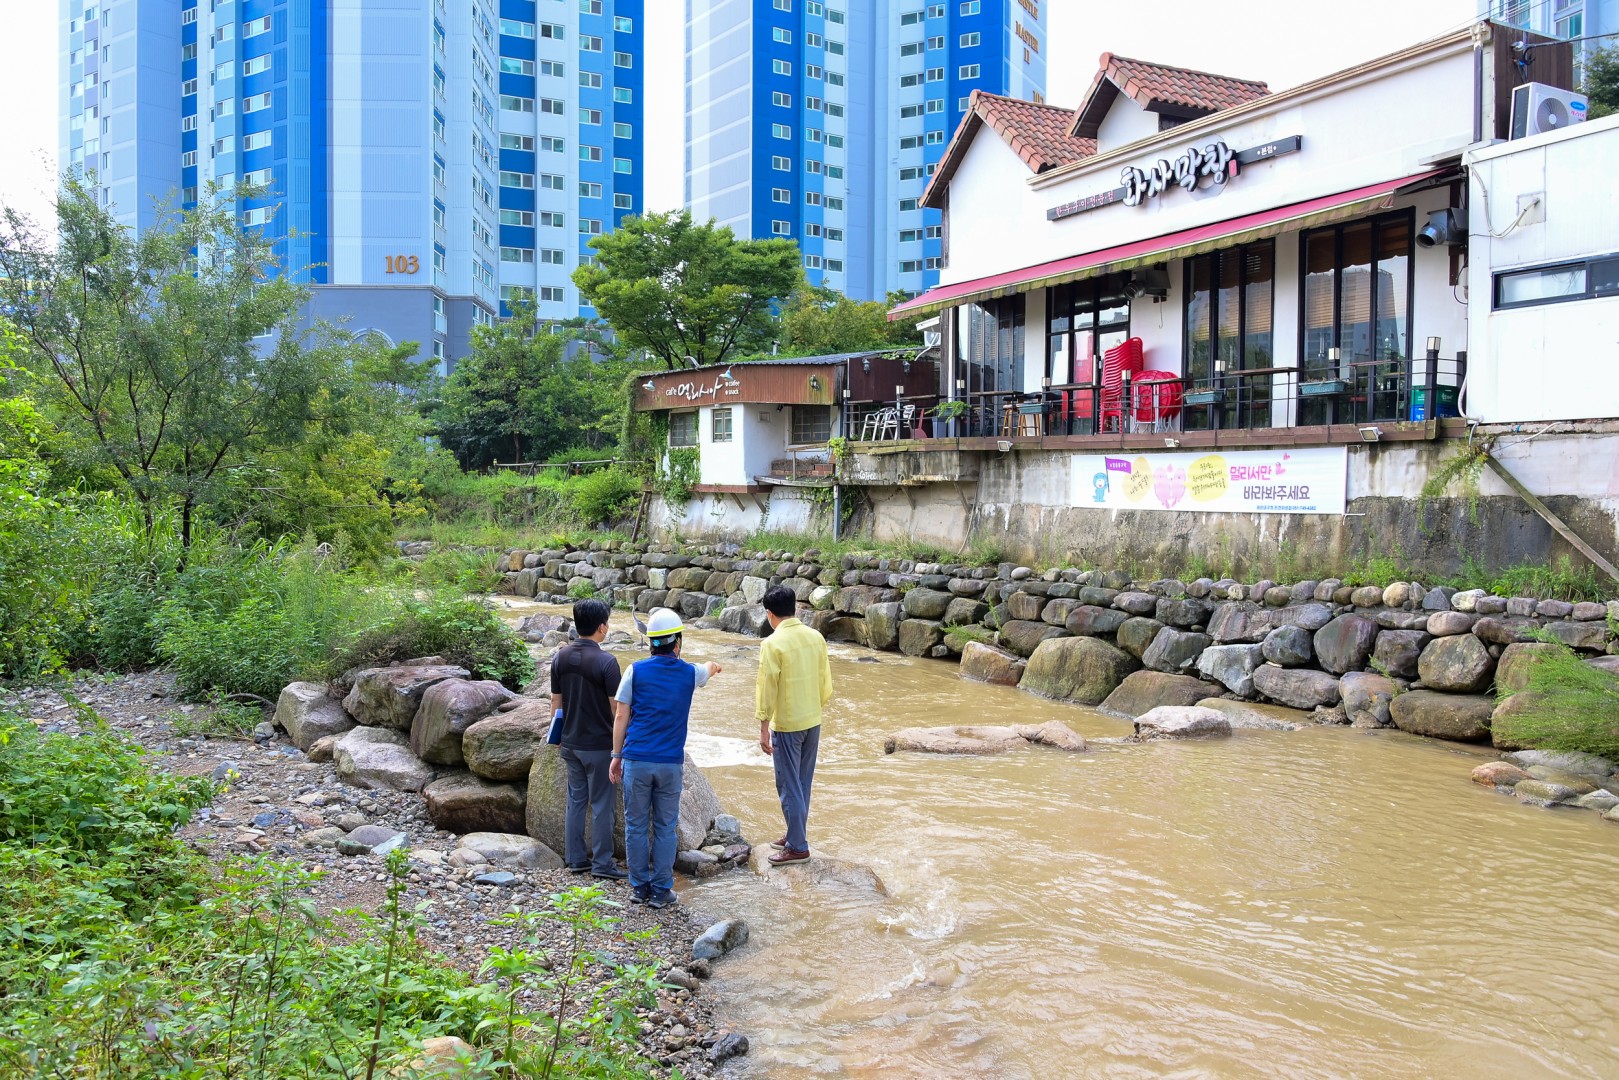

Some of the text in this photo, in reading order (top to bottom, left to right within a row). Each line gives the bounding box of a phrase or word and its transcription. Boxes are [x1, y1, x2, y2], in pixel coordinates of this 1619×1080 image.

[1015, 20, 1039, 54] MASTER
[1120, 141, 1233, 207] 화사막창
[385, 255, 420, 275] 103
[1230, 465, 1272, 481] 멀리서만
[1243, 485, 1310, 501] 바라봐주세요
